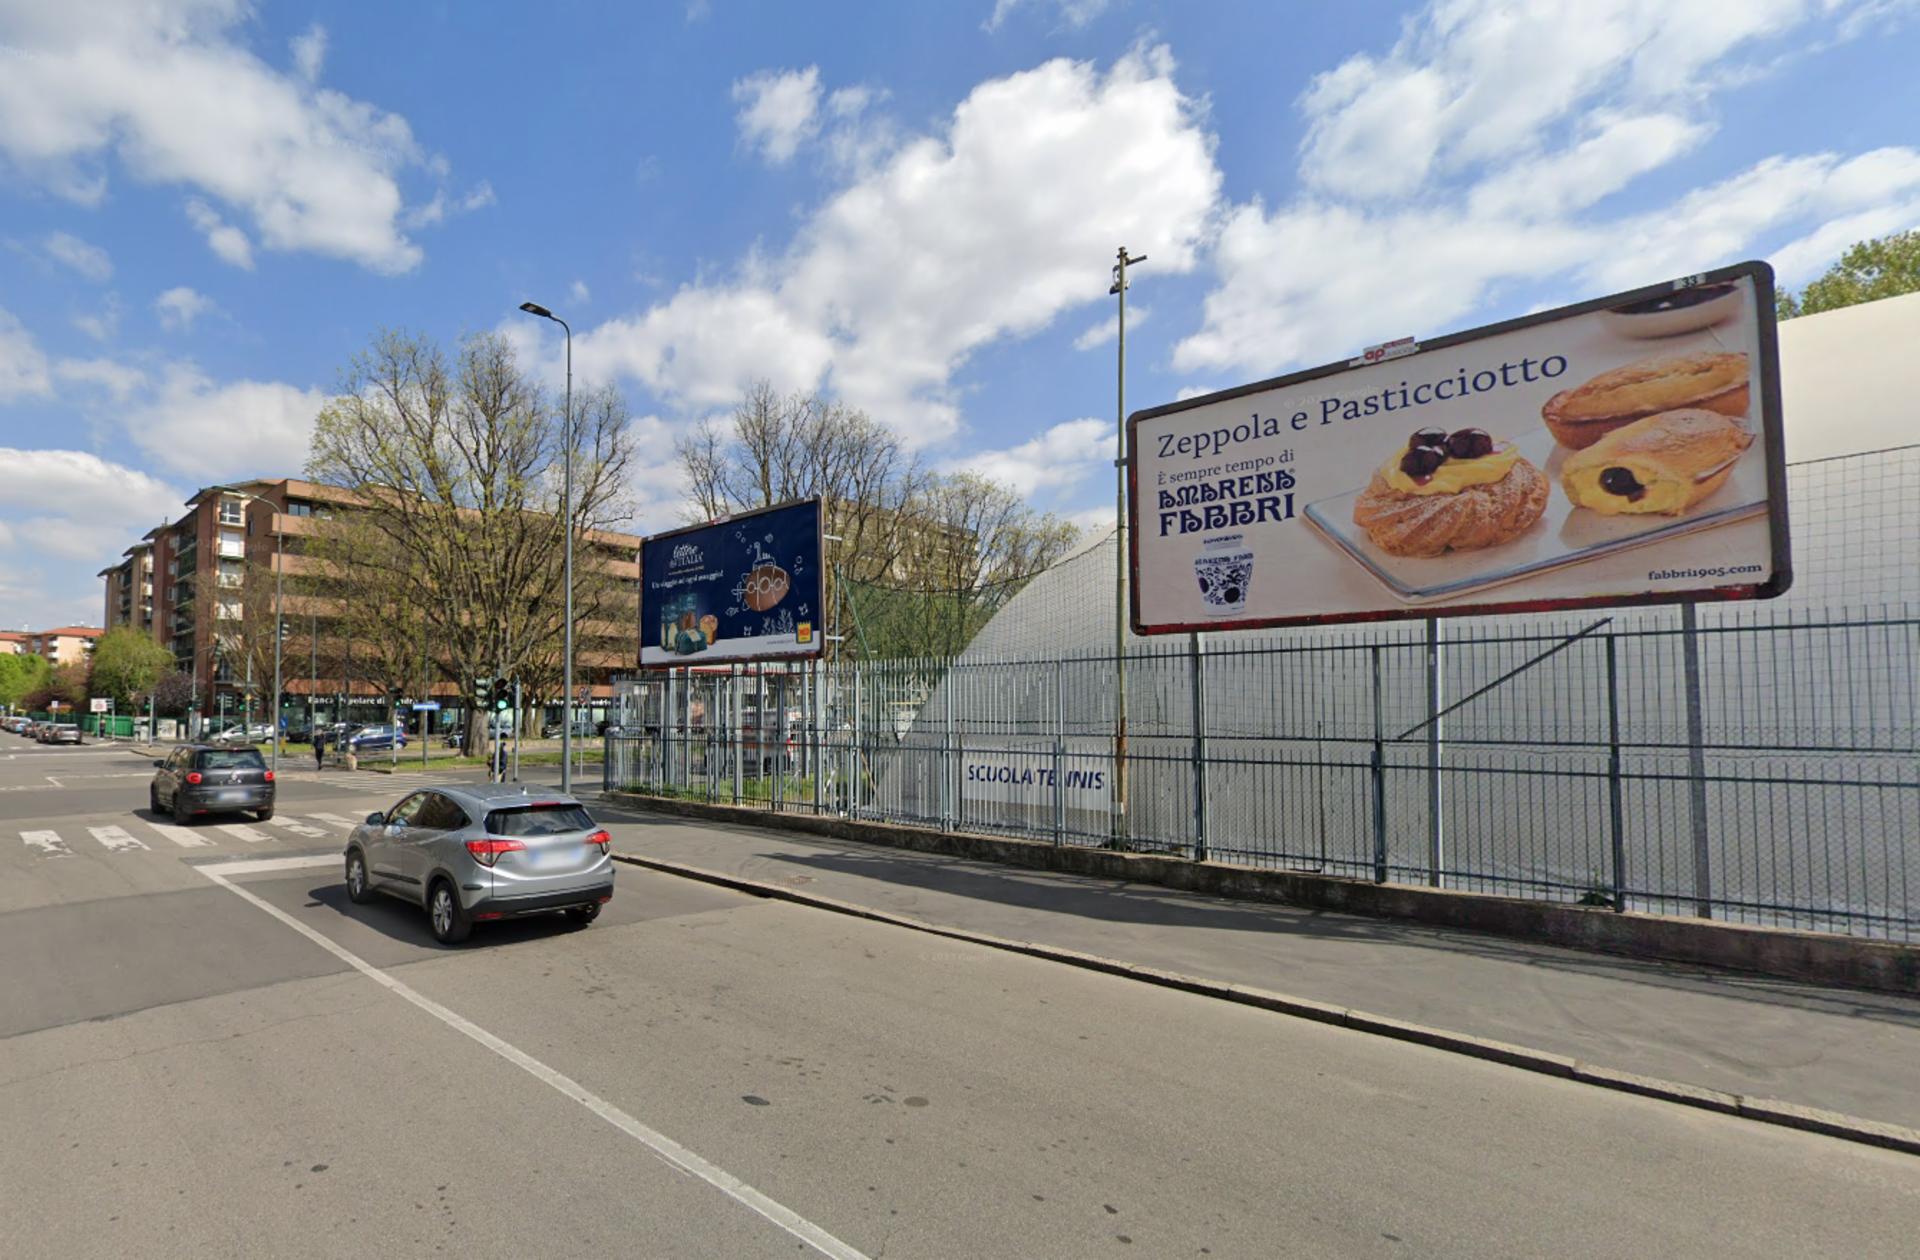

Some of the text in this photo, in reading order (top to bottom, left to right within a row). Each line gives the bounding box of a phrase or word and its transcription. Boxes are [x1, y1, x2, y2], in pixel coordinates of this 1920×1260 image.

[1158, 354, 1568, 459] Zeppola e Pasticciotto
[1157, 449, 1294, 485] È sempre tempo di
[1158, 470, 1296, 509] AMARENA
[1158, 493, 1295, 537] FABBRI
[1649, 564, 1762, 580] fabbri1905.com
[968, 764, 1033, 785] SCUOLA
